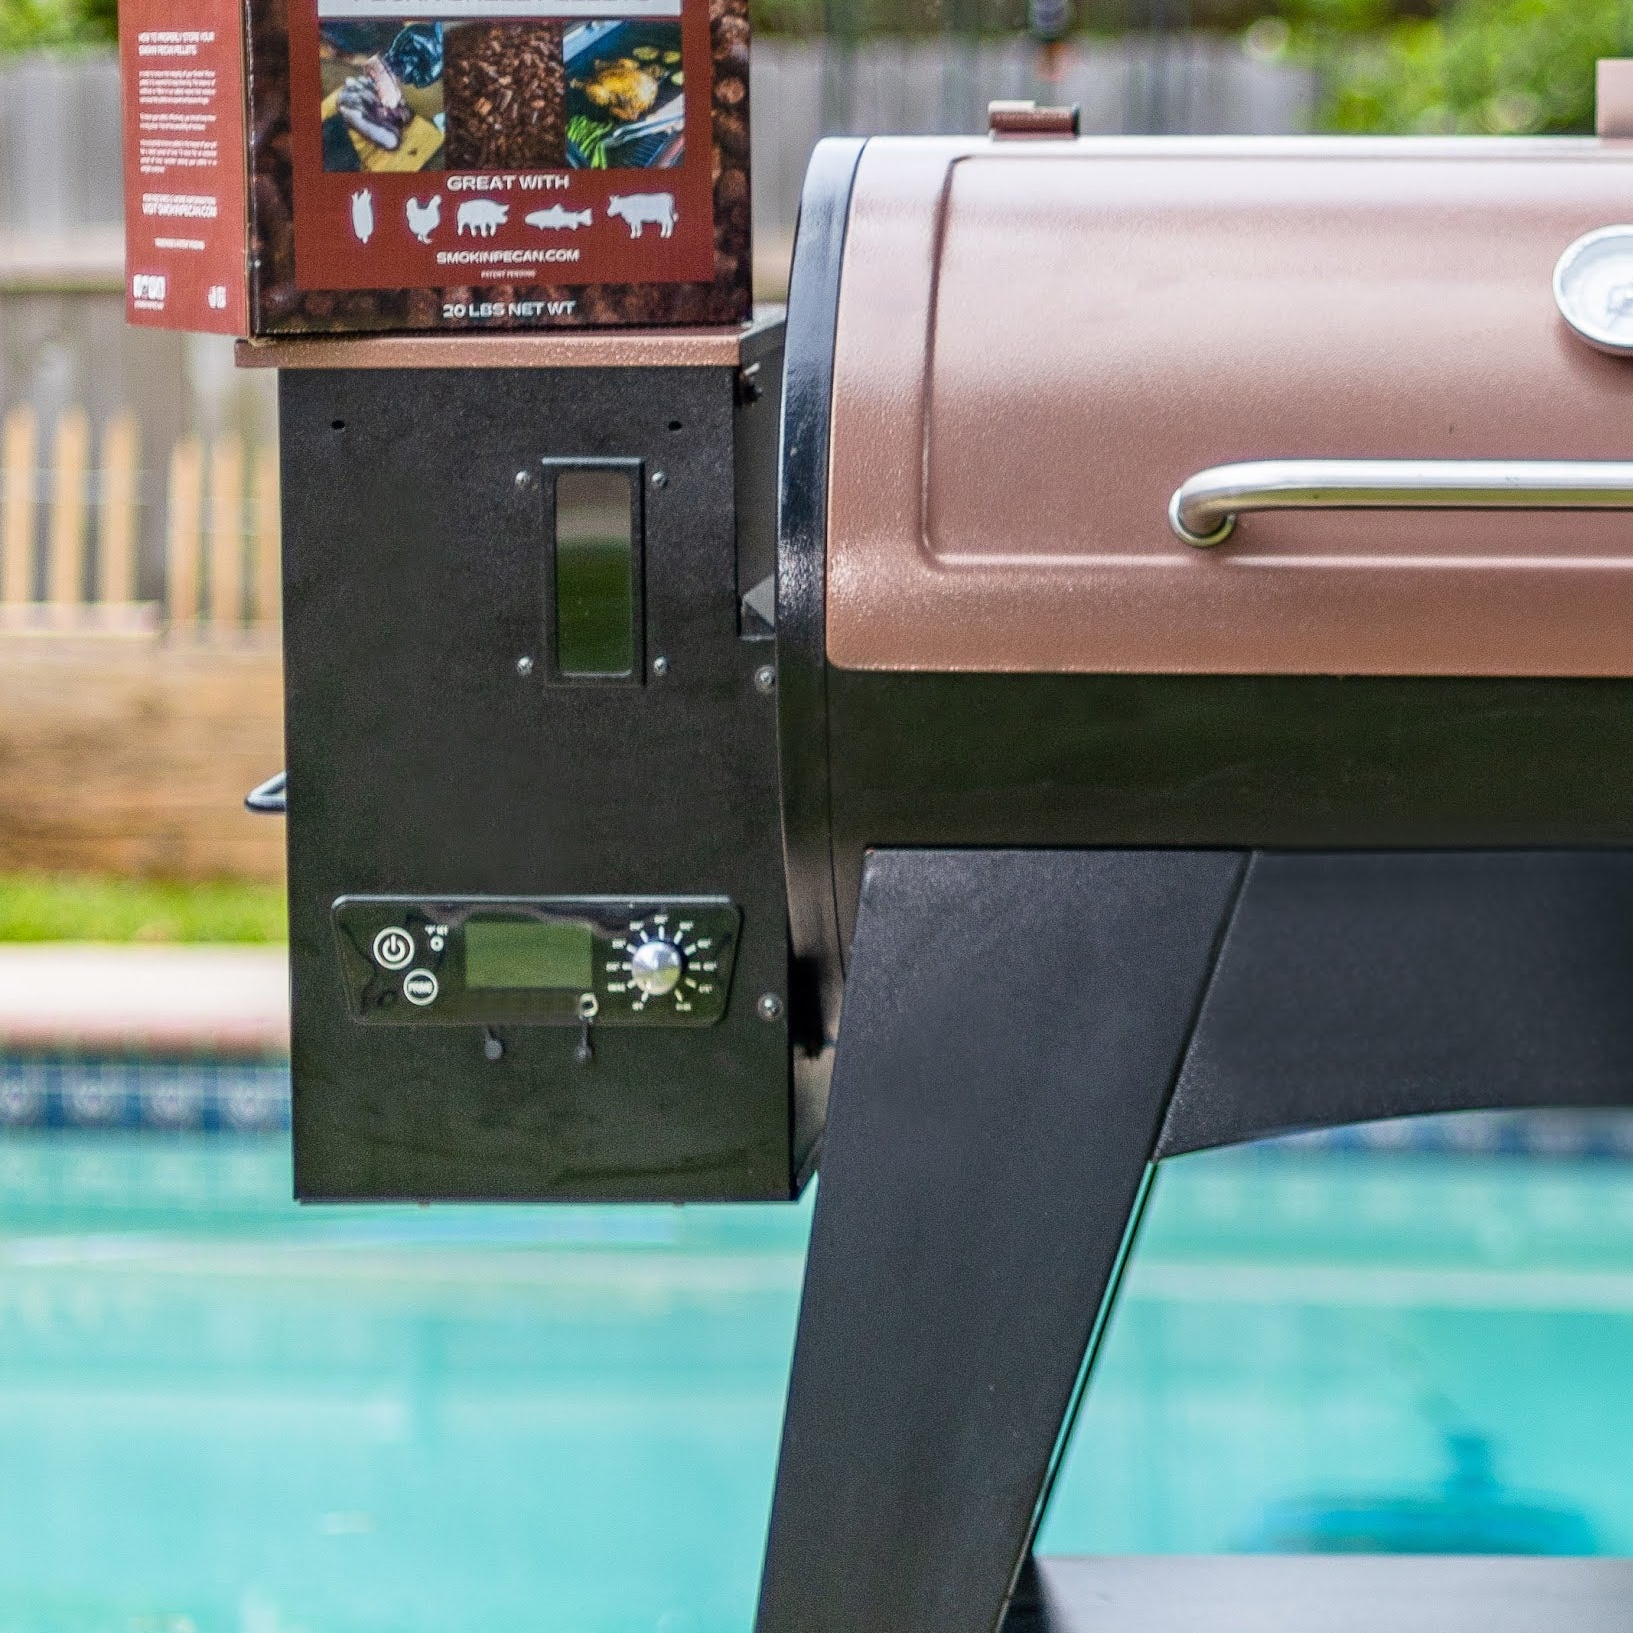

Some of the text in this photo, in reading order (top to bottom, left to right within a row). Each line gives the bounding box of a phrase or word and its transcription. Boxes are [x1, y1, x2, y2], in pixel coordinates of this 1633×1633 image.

[447, 174, 570, 191] GREAT WITH
[436, 249, 580, 264] SMOKINPECAN.COM
[443, 300, 577, 318] 20 LBS NET WT
